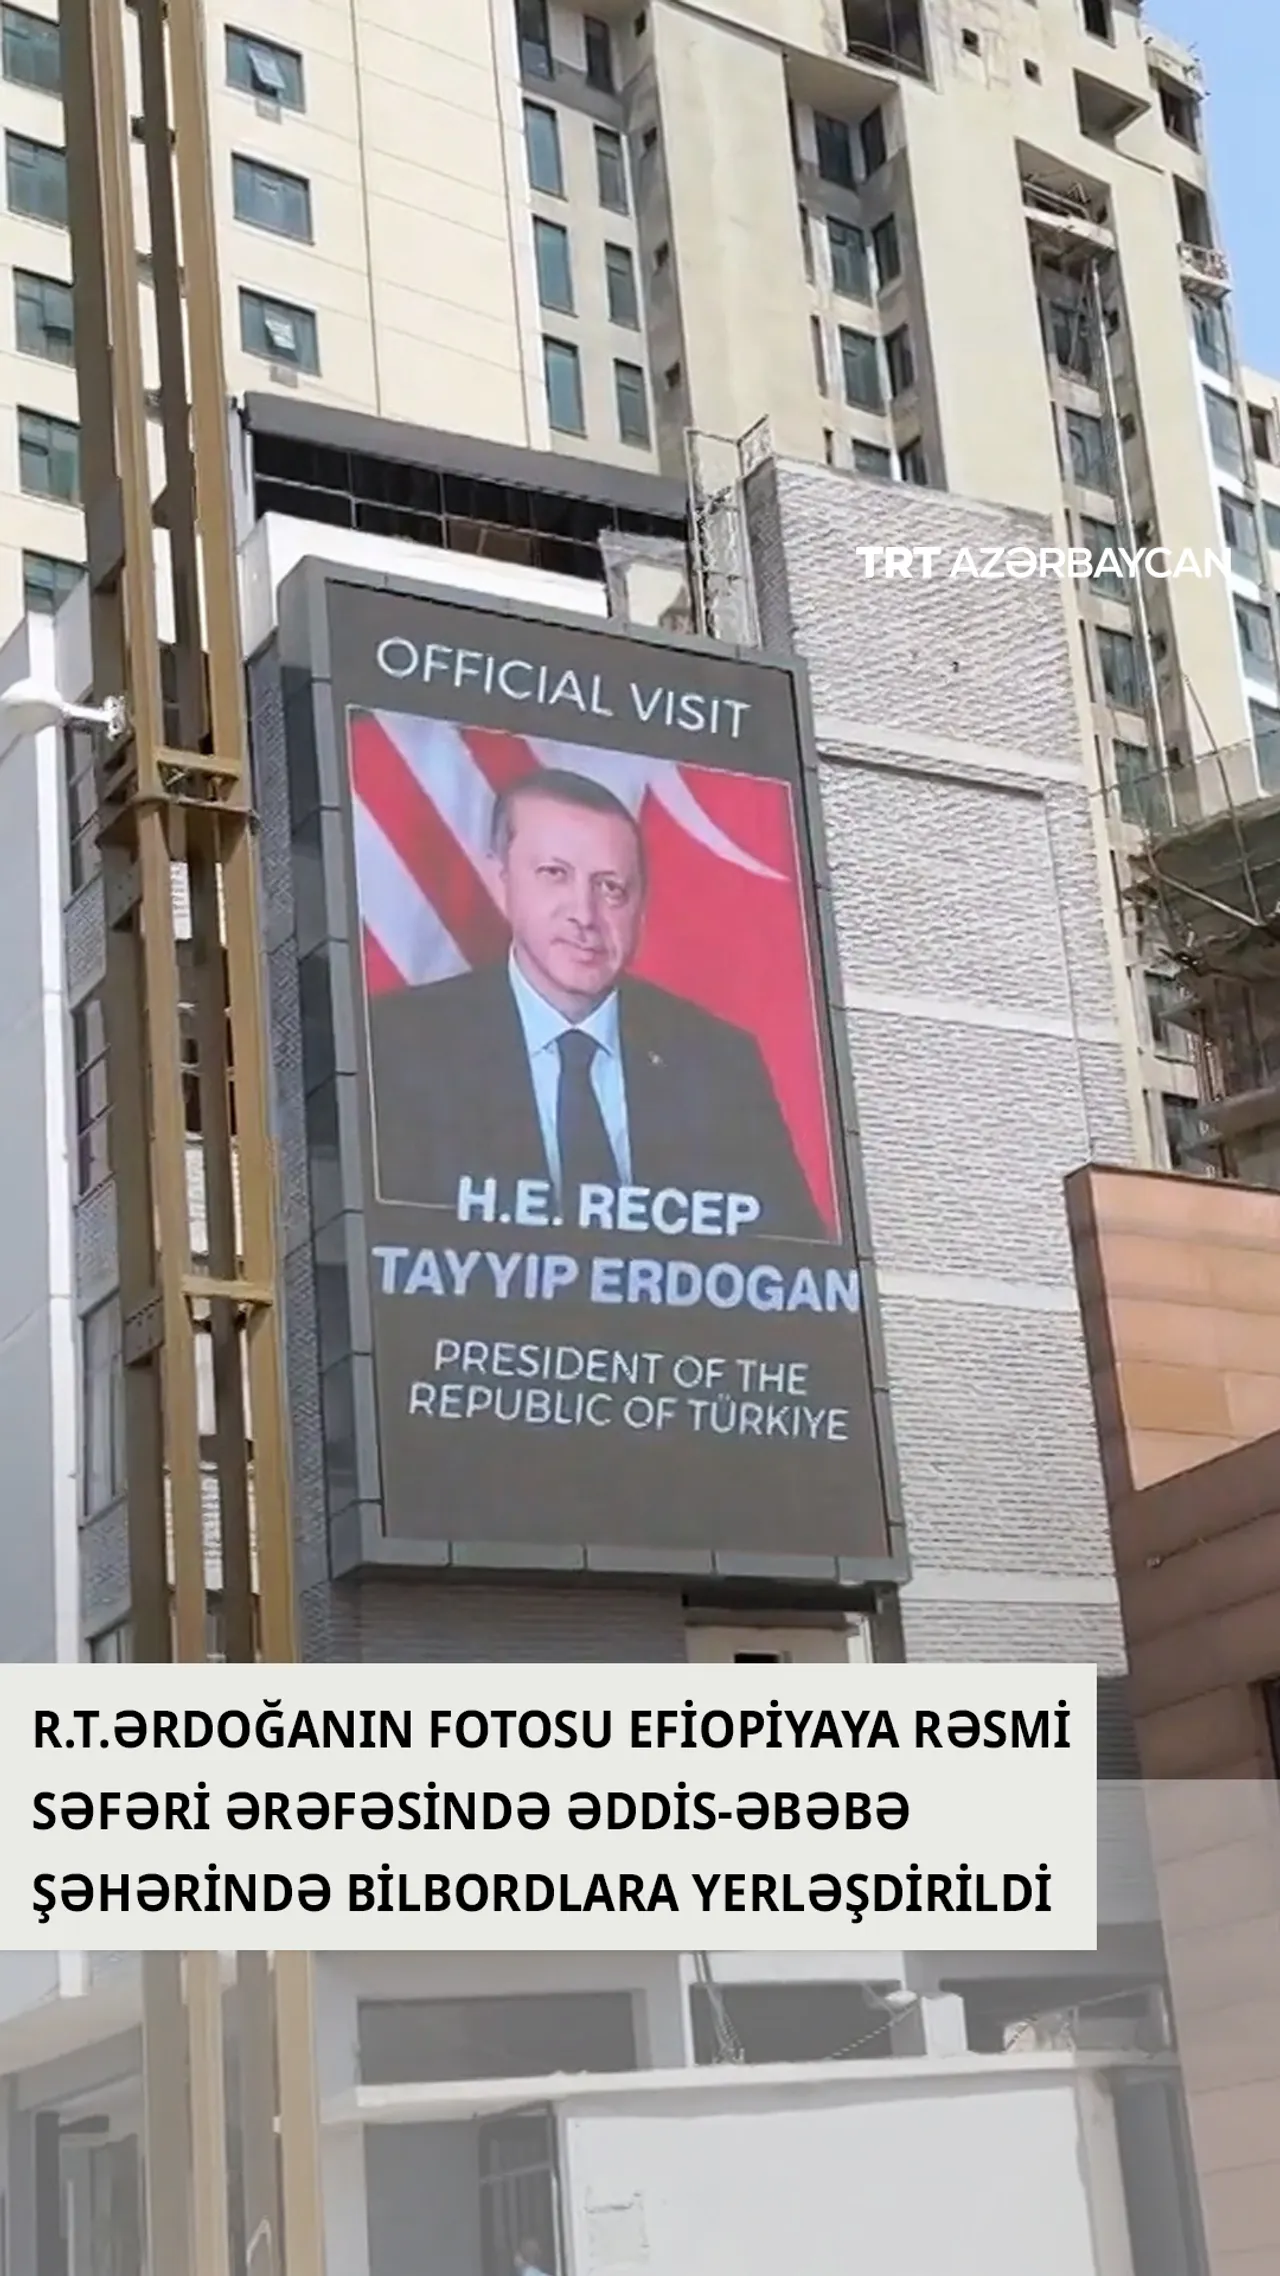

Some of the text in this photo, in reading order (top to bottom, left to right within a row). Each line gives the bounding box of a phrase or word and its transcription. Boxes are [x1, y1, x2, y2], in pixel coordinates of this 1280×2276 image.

[376, 636, 752, 739] OFFICIAL VISIT
[457, 1175, 760, 1237] H.E. RECEP
[372, 1246, 860, 1313] TAYYIP ERDOGAN
[434, 1338, 808, 1396] PRESIDENT OF THE
[408, 1382, 849, 1441] REPUBLIC OF TÜRKIYE
